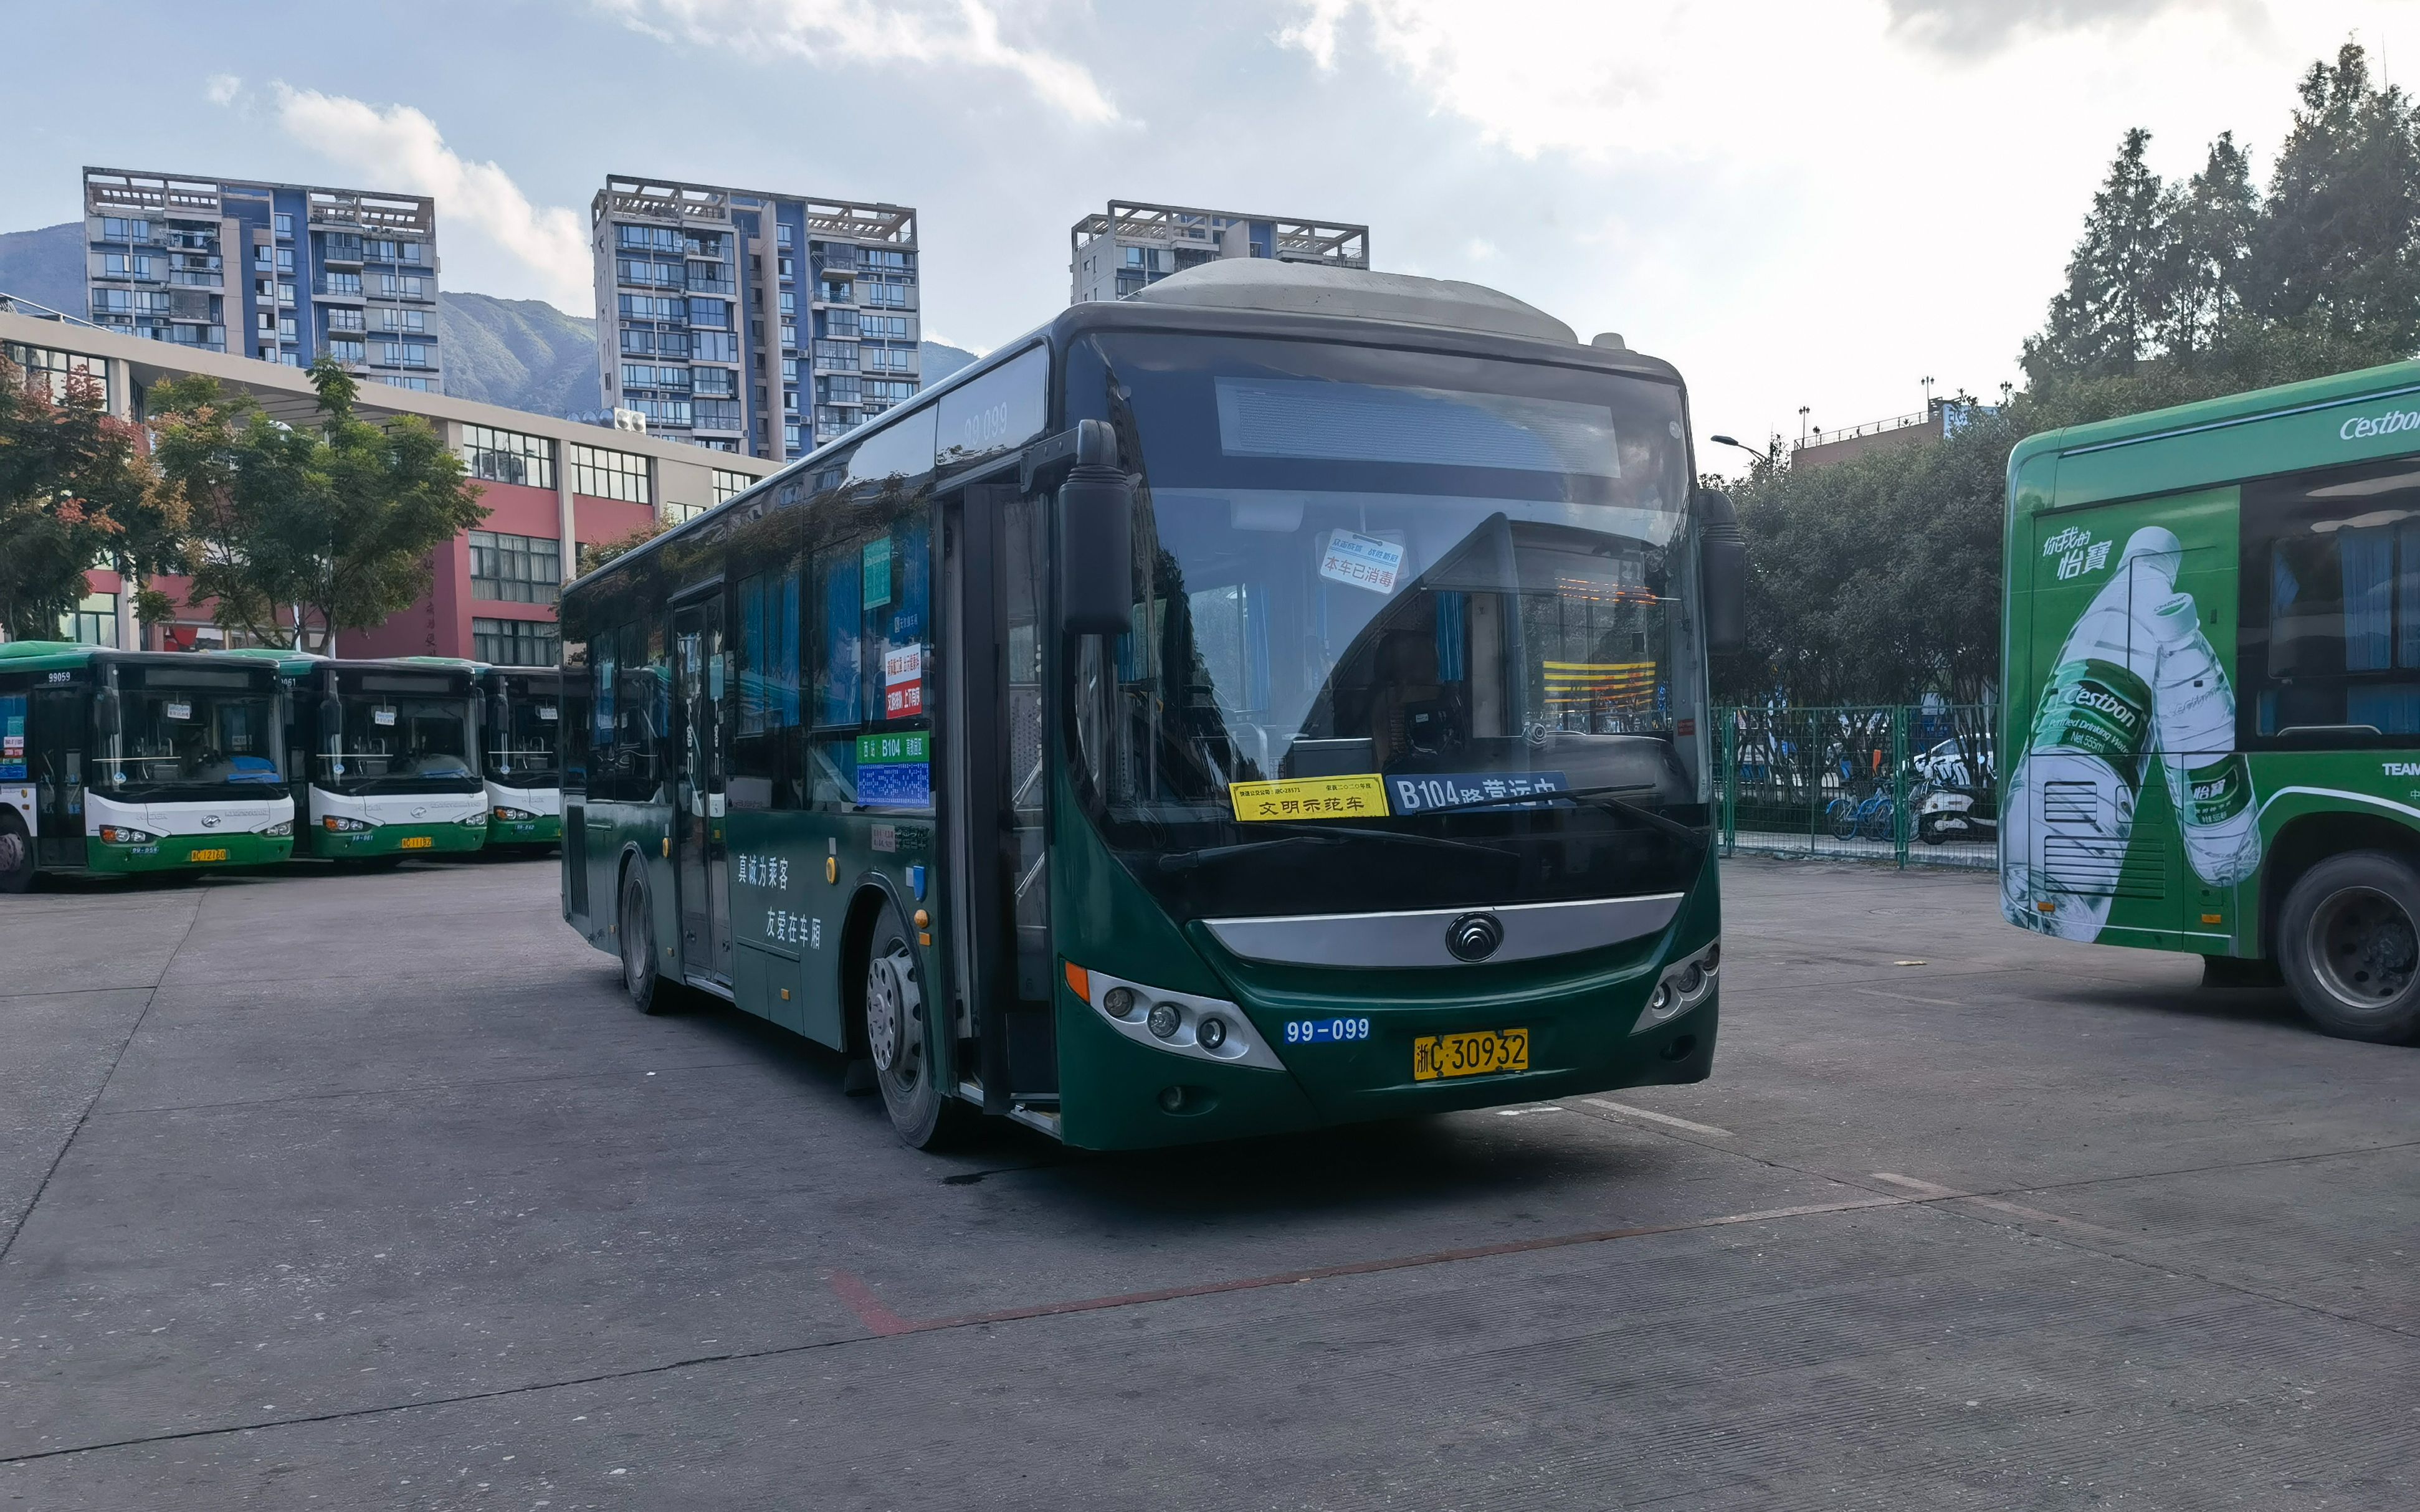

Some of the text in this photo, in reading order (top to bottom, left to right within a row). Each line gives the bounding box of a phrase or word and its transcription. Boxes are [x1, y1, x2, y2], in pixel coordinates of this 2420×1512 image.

[2043, 526, 2091, 557] 你我的
[1325, 556, 1394, 587] 本车已消毒
[2057, 540, 2112, 580] 怡寶
[49, 672, 70, 683] 99059
[2064, 687, 2136, 728] C'estbon
[2070, 731, 2084, 744] Net
[2079, 721, 2112, 741] Drinking
[882, 738, 900, 758] B104
[1259, 796, 1365, 815] 文明示范车
[738, 852, 788, 891] 真诚为乘客
[766, 905, 821, 951] 友爱在车厢
[1287, 1018, 1370, 1042] 99-099
